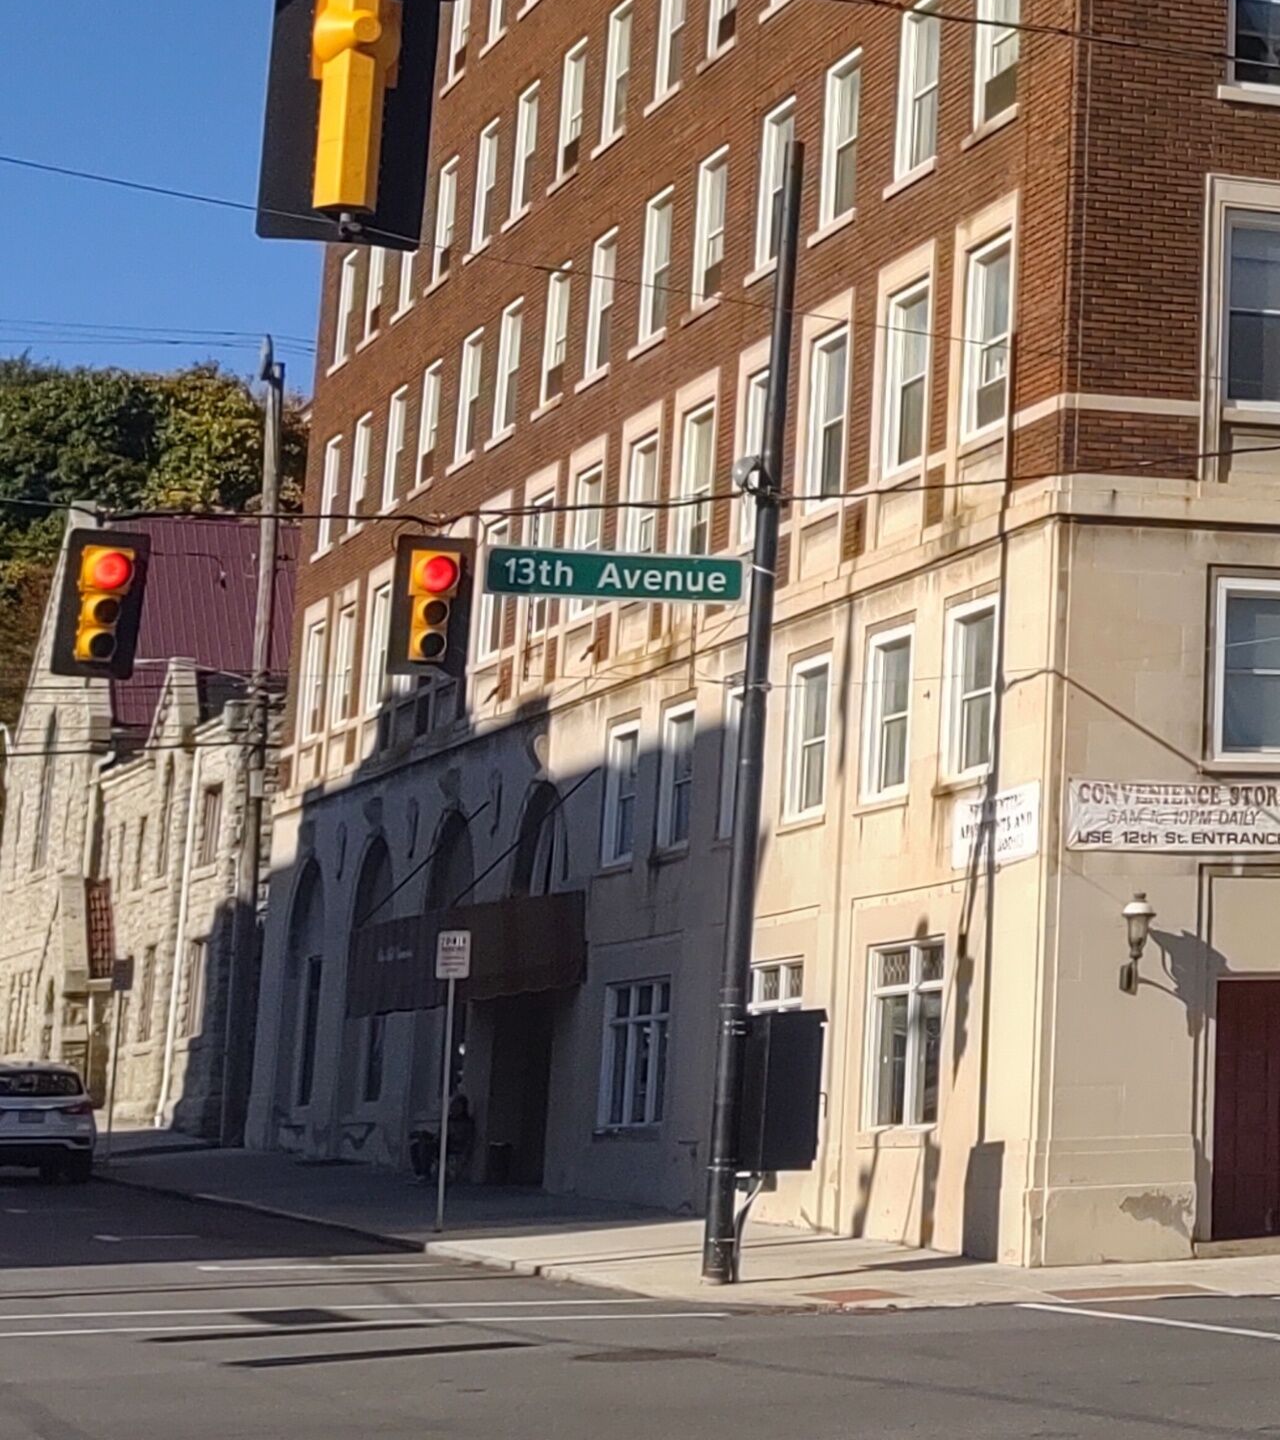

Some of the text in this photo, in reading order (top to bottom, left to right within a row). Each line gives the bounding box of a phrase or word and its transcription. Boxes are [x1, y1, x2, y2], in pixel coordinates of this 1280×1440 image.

[504, 557, 727, 593] 13th Avenue
[1079, 783, 1221, 806] CONVENIENCE
[1218, 809, 1260, 826] DAILY
[1078, 830, 1112, 844] USE
[1121, 830, 1158, 844] 12th
